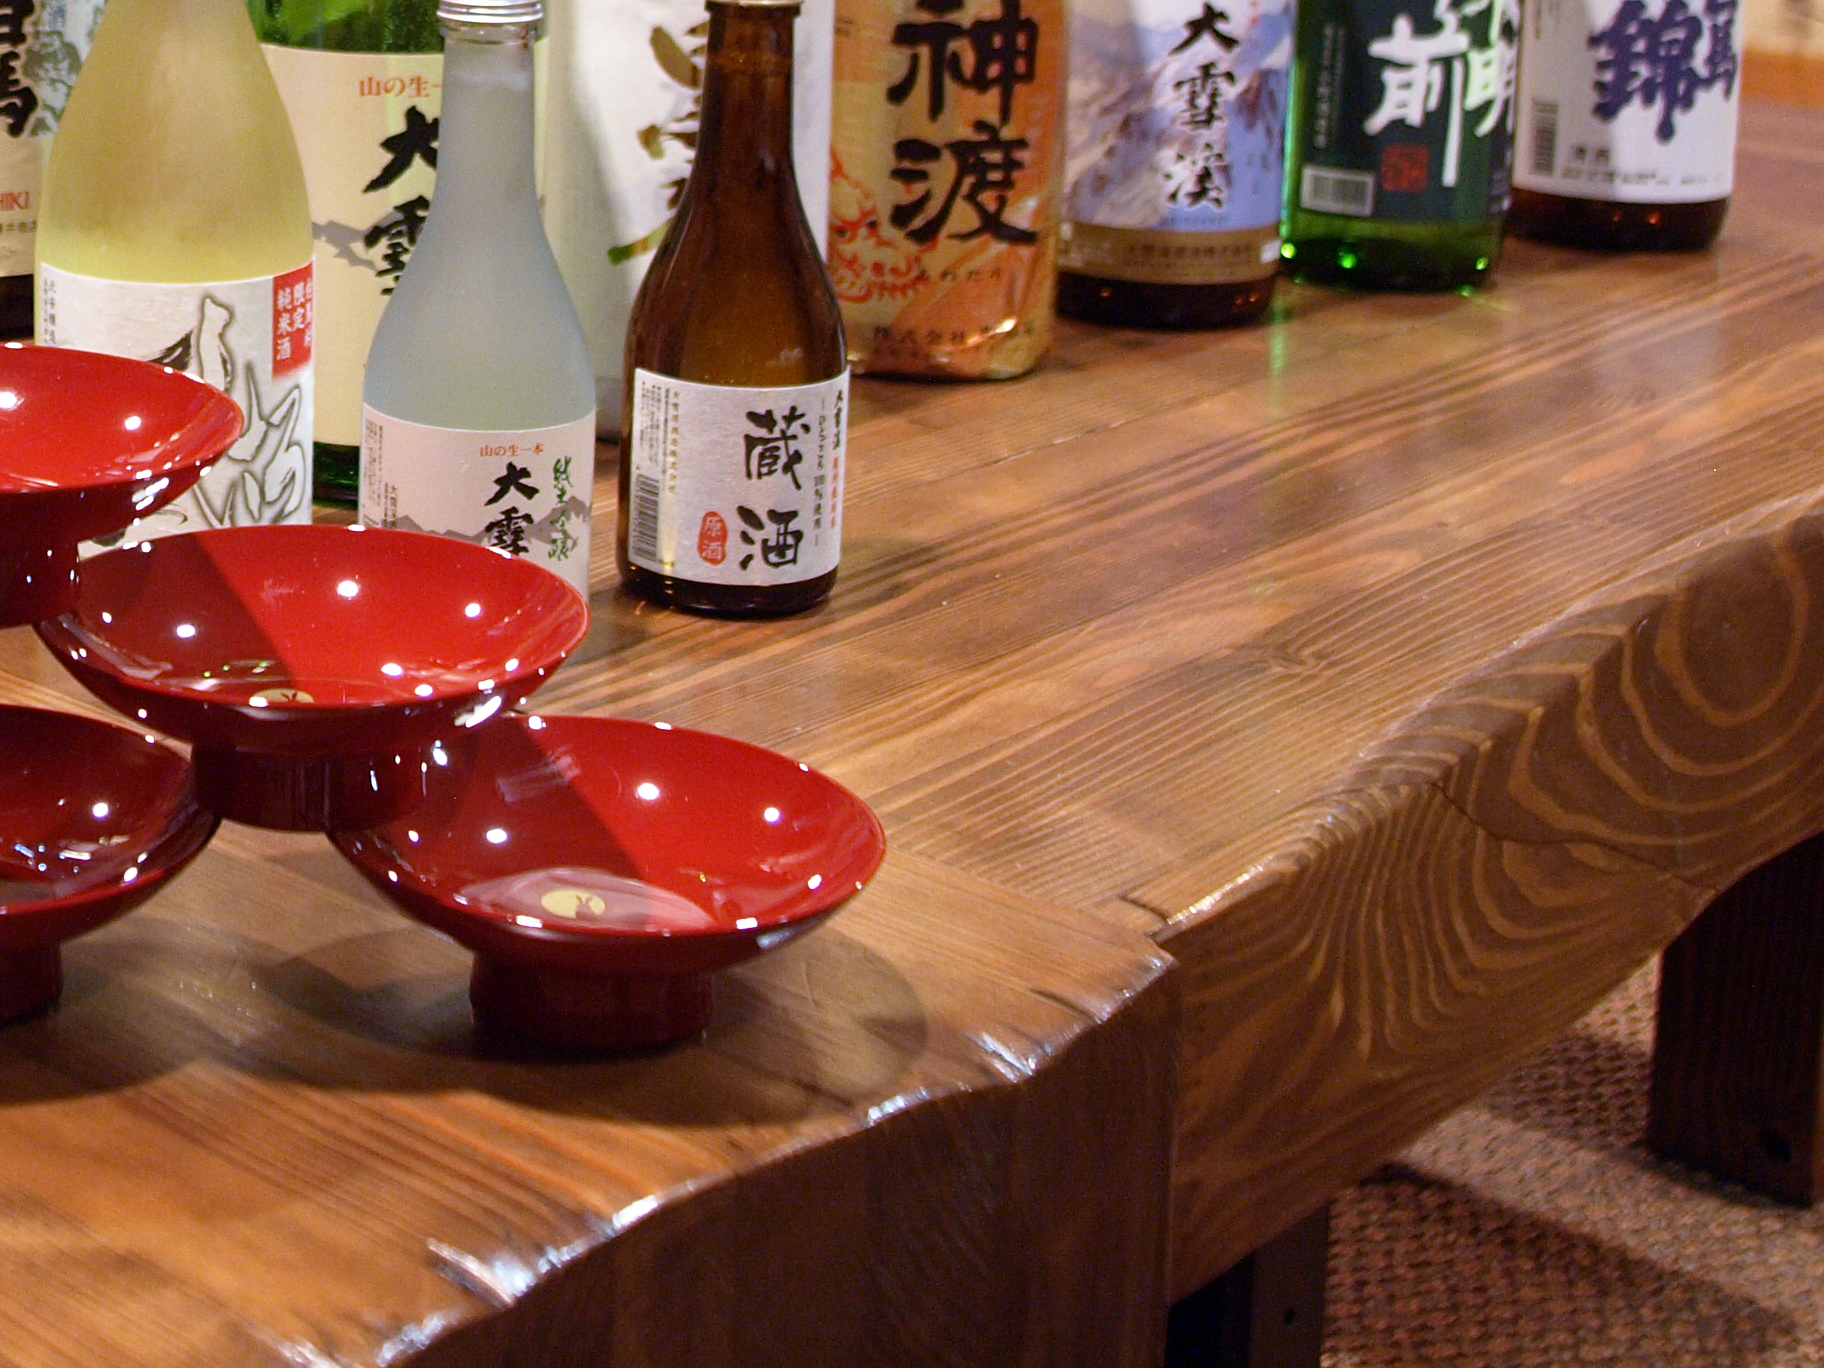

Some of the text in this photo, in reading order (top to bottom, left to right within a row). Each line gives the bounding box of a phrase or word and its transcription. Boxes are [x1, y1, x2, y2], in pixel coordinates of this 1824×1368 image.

[1170, 0, 1240, 210] 大雪渓
[736, 405, 812, 571] 蔵酒
